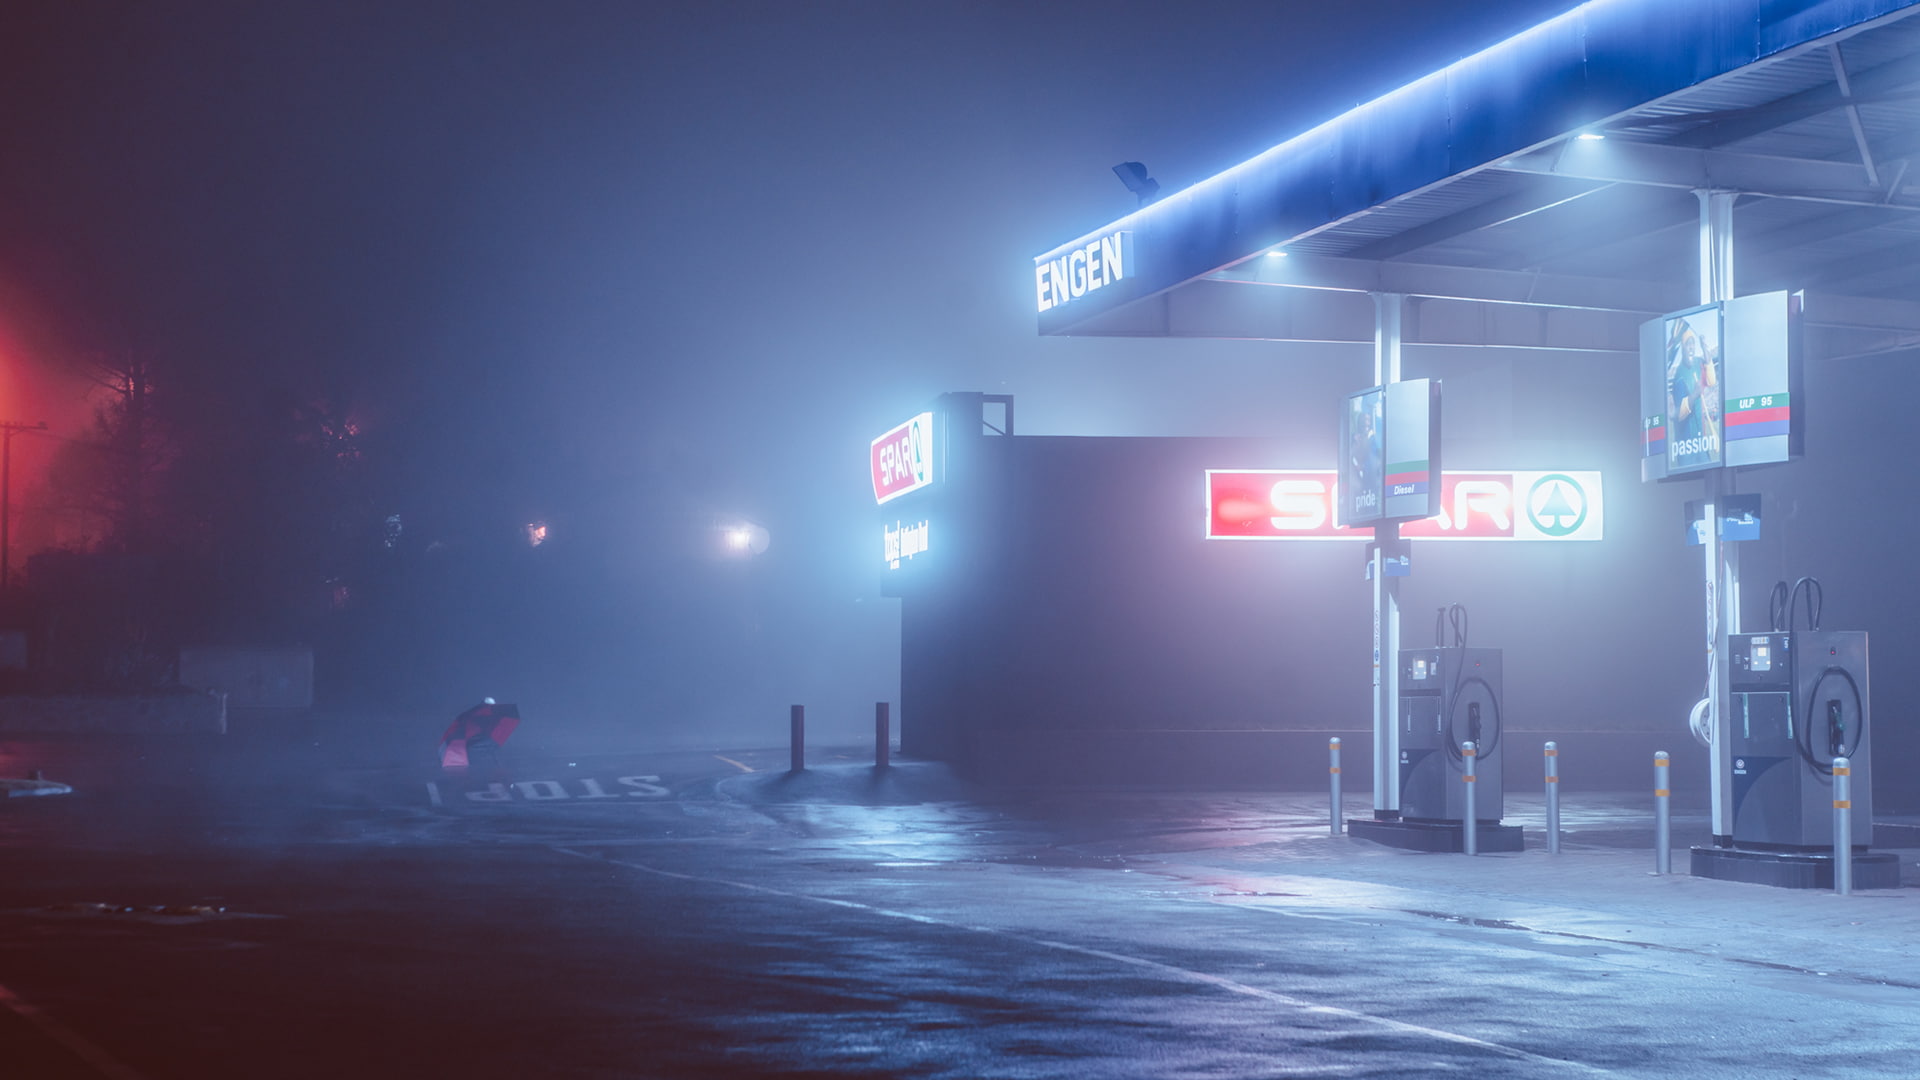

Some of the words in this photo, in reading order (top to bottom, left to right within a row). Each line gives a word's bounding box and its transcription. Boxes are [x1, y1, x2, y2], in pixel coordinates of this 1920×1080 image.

[1036, 231, 1123, 312] ENGEN
[1739, 398, 1755, 409] ULP
[1761, 396, 1773, 406] 95
[1671, 432, 1718, 461] passion
[880, 436, 914, 487] SPAR
[1355, 490, 1376, 512] pride
[1394, 483, 1415, 495] Diesel
[1270, 480, 1510, 530] SR
[465, 775, 671, 801] STOP
